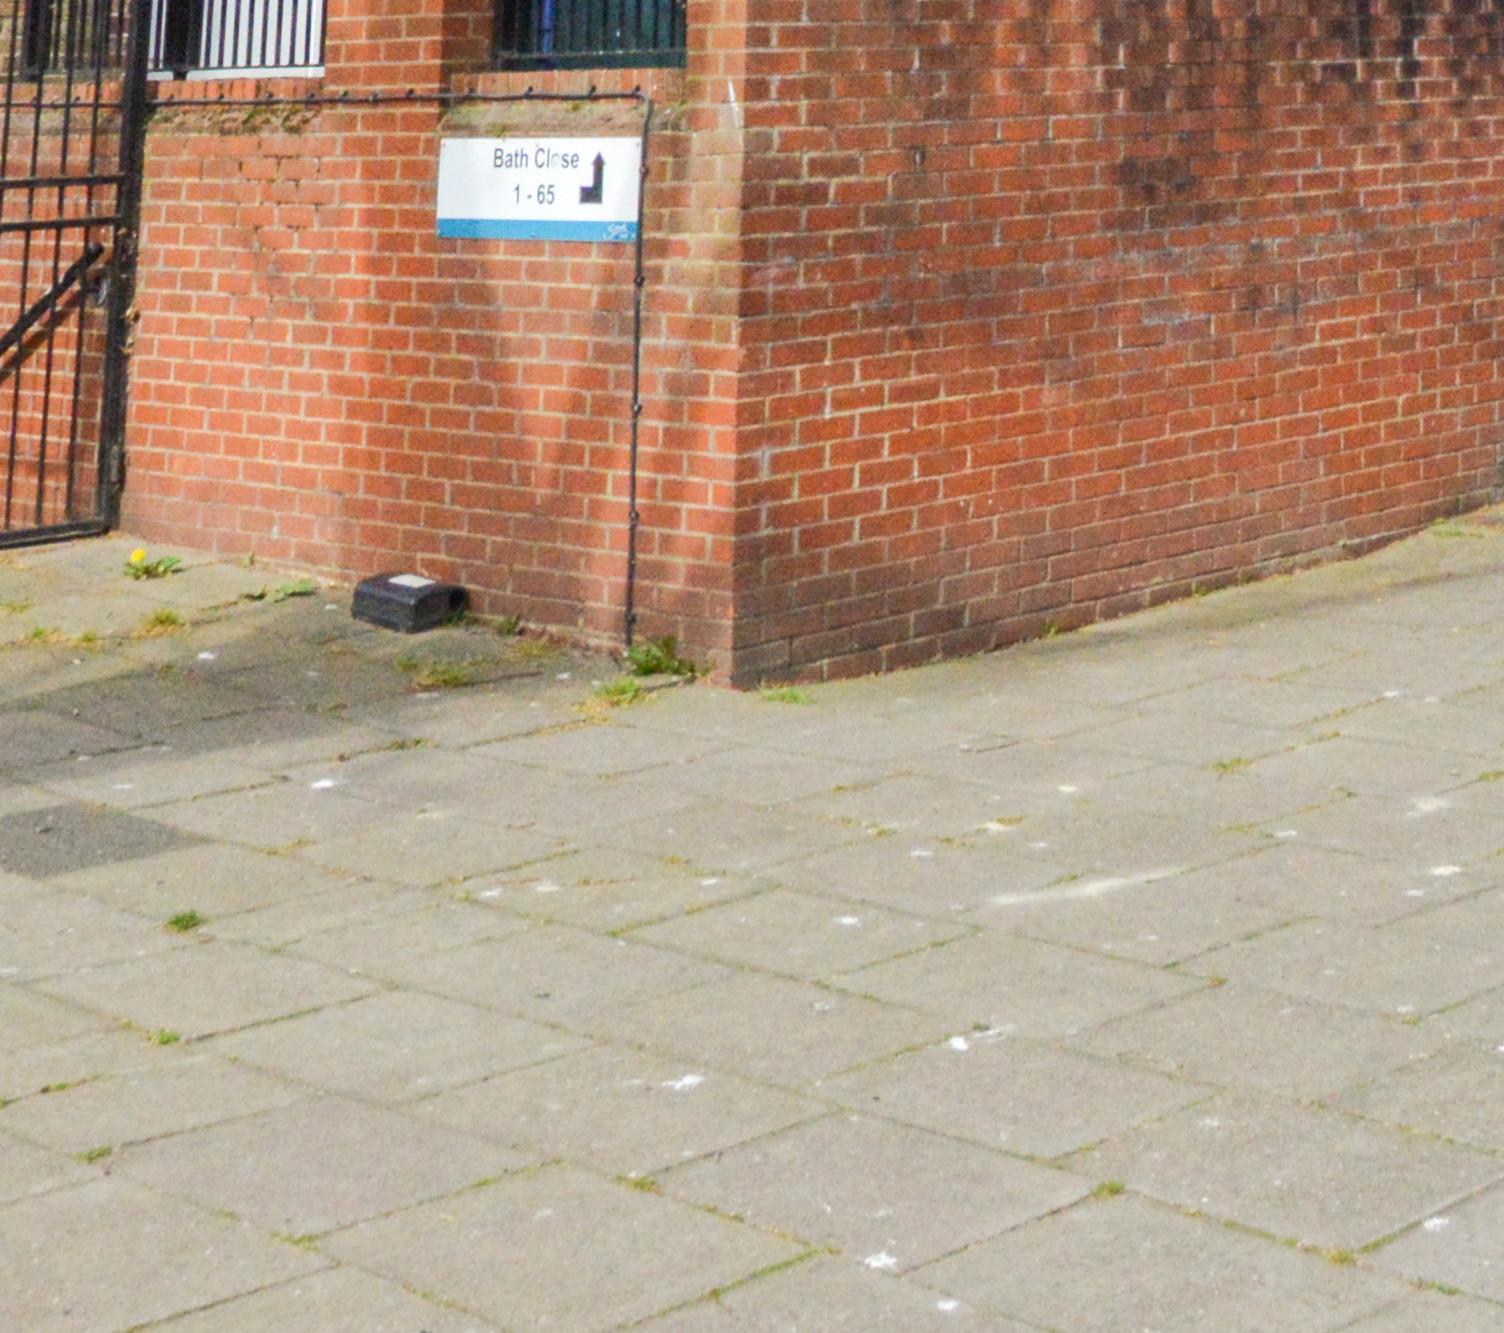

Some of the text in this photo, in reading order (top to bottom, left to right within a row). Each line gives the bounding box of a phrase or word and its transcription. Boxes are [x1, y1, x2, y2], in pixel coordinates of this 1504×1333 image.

[493, 147, 579, 169] Bath Close
[513, 184, 520, 204] 1
[536, 183, 555, 205] 65
